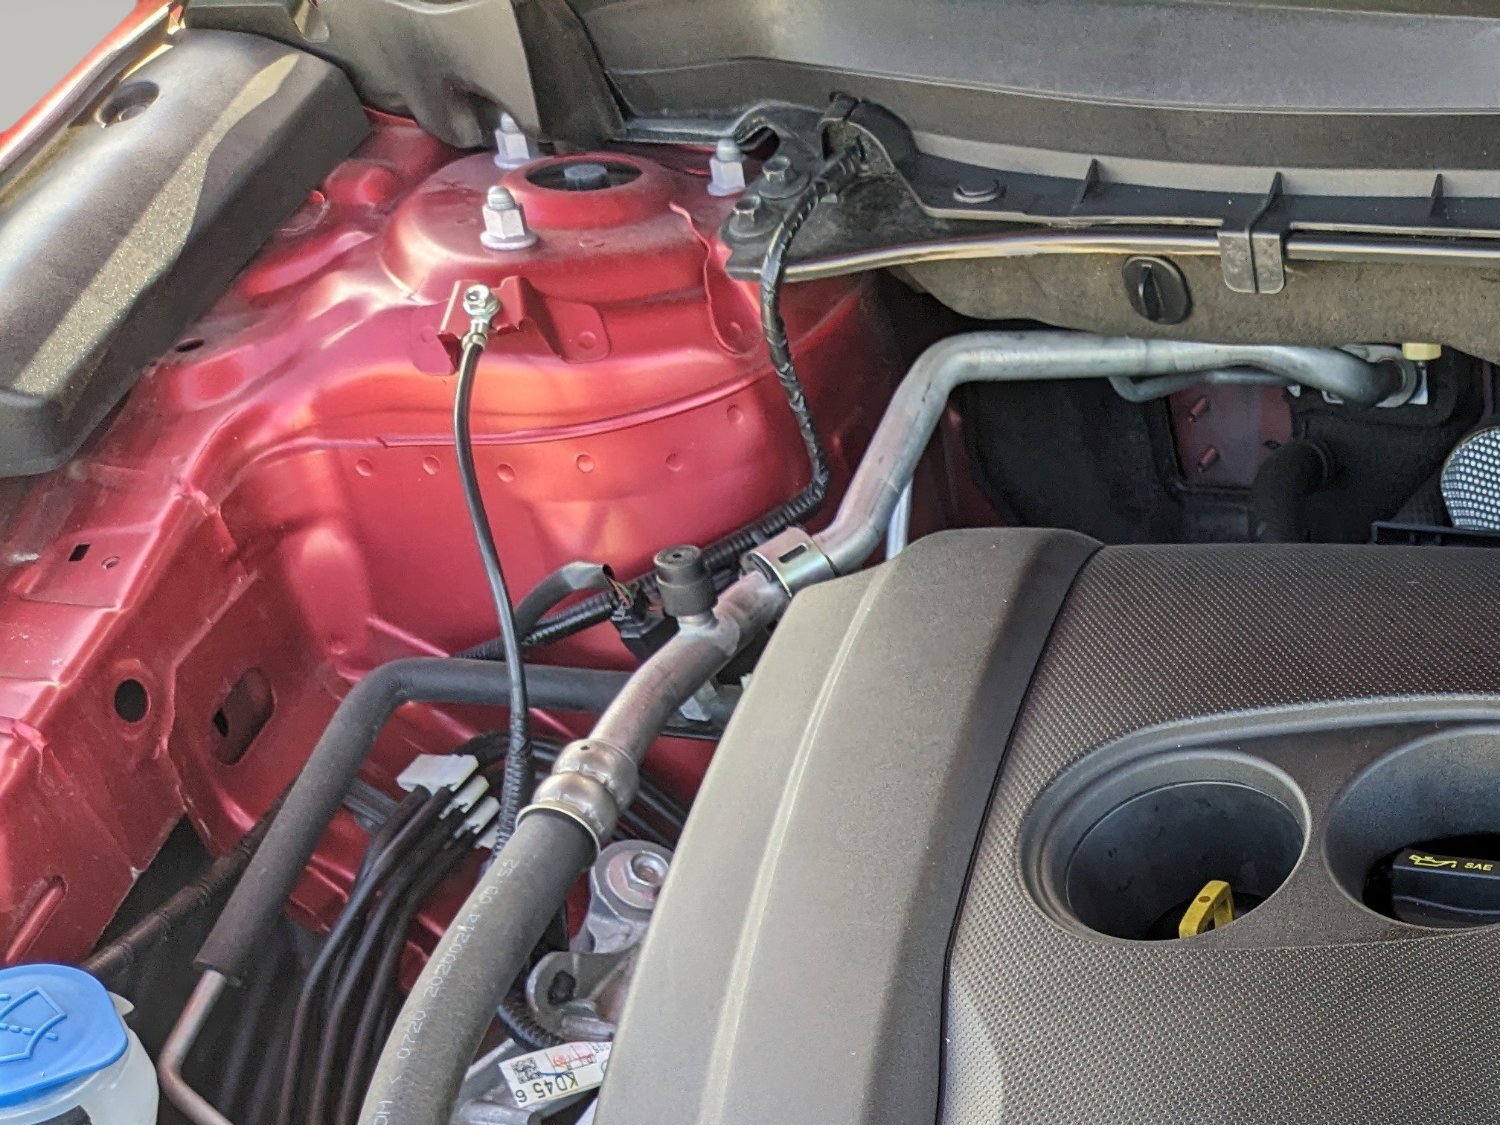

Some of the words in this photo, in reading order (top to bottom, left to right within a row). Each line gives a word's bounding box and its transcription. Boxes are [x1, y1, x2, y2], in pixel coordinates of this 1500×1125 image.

[1464, 862, 1493, 872] SAE
[533, 1071, 579, 1099] KD45
[515, 1089, 528, 1103] 6
